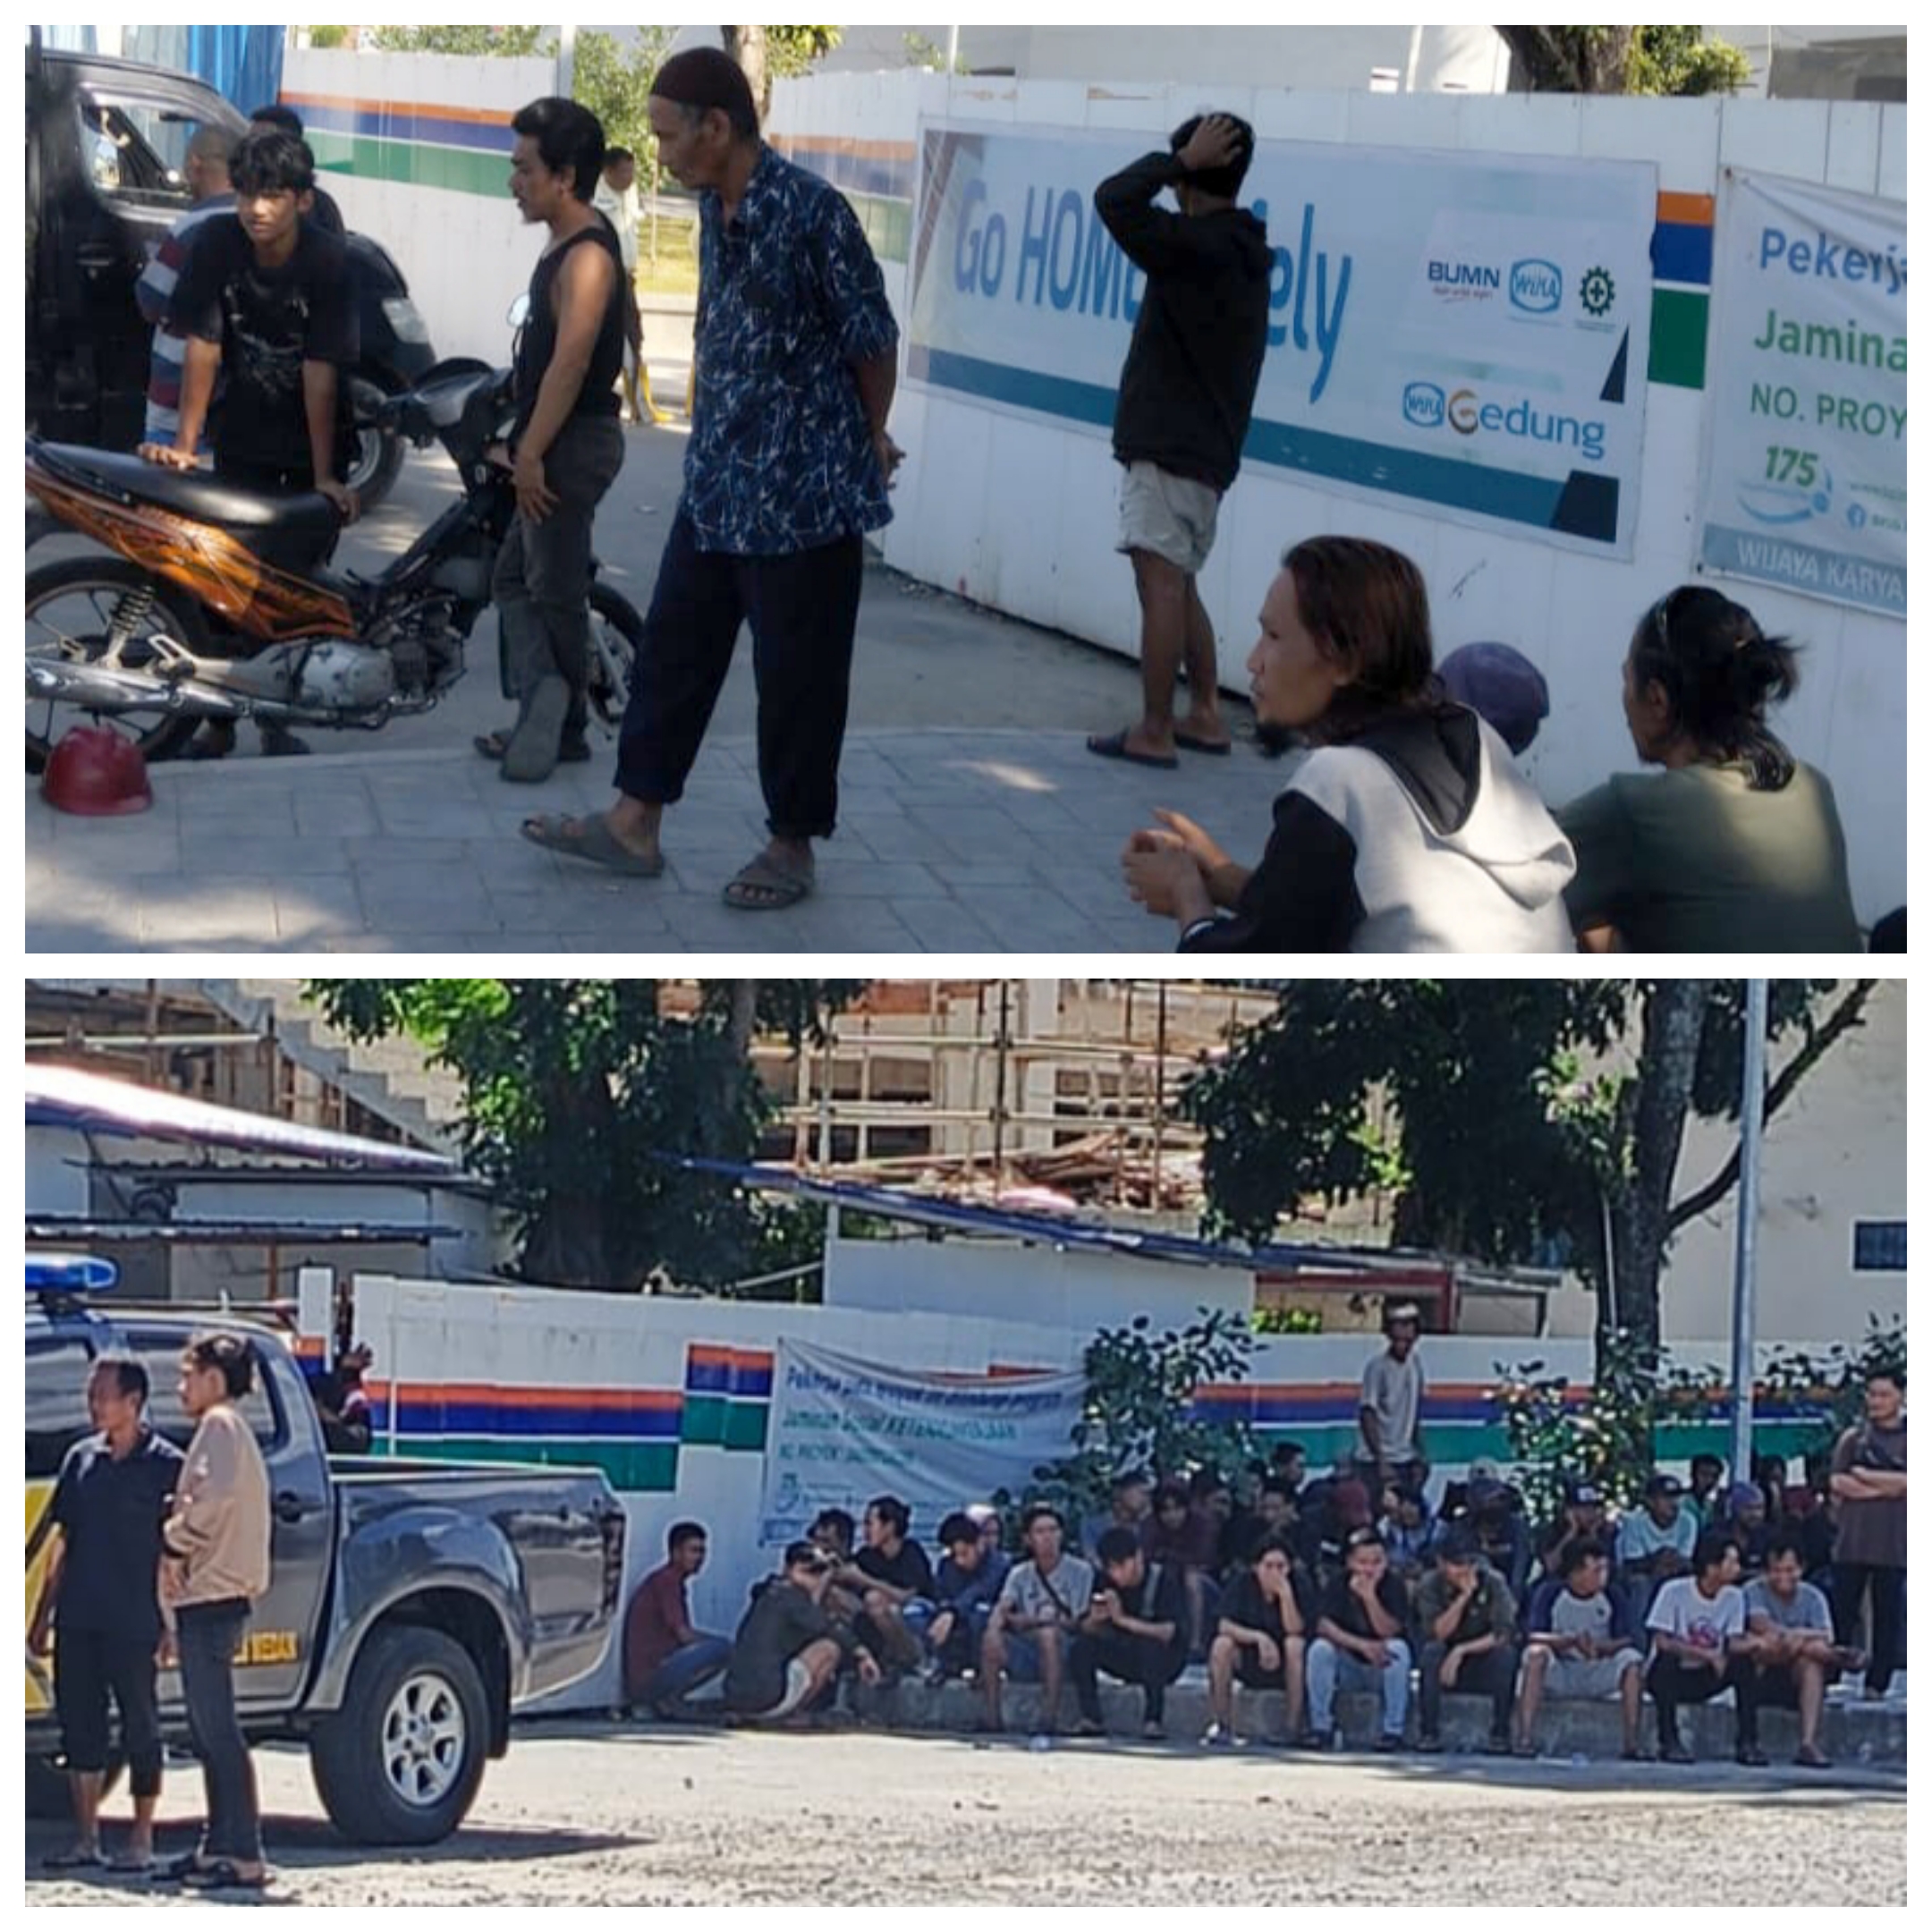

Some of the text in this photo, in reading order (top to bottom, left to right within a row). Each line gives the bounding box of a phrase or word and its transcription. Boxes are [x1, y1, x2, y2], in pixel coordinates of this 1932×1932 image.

[953, 178, 1007, 300] Go
[1759, 226, 1907, 294] Pekerj
[1428, 260, 1501, 289] BUMN
[1750, 382, 1805, 421] NO.
[1448, 390, 1605, 460] Gedung
[1766, 445, 1818, 487] 175
[1737, 537, 1818, 582] WIJAYA
